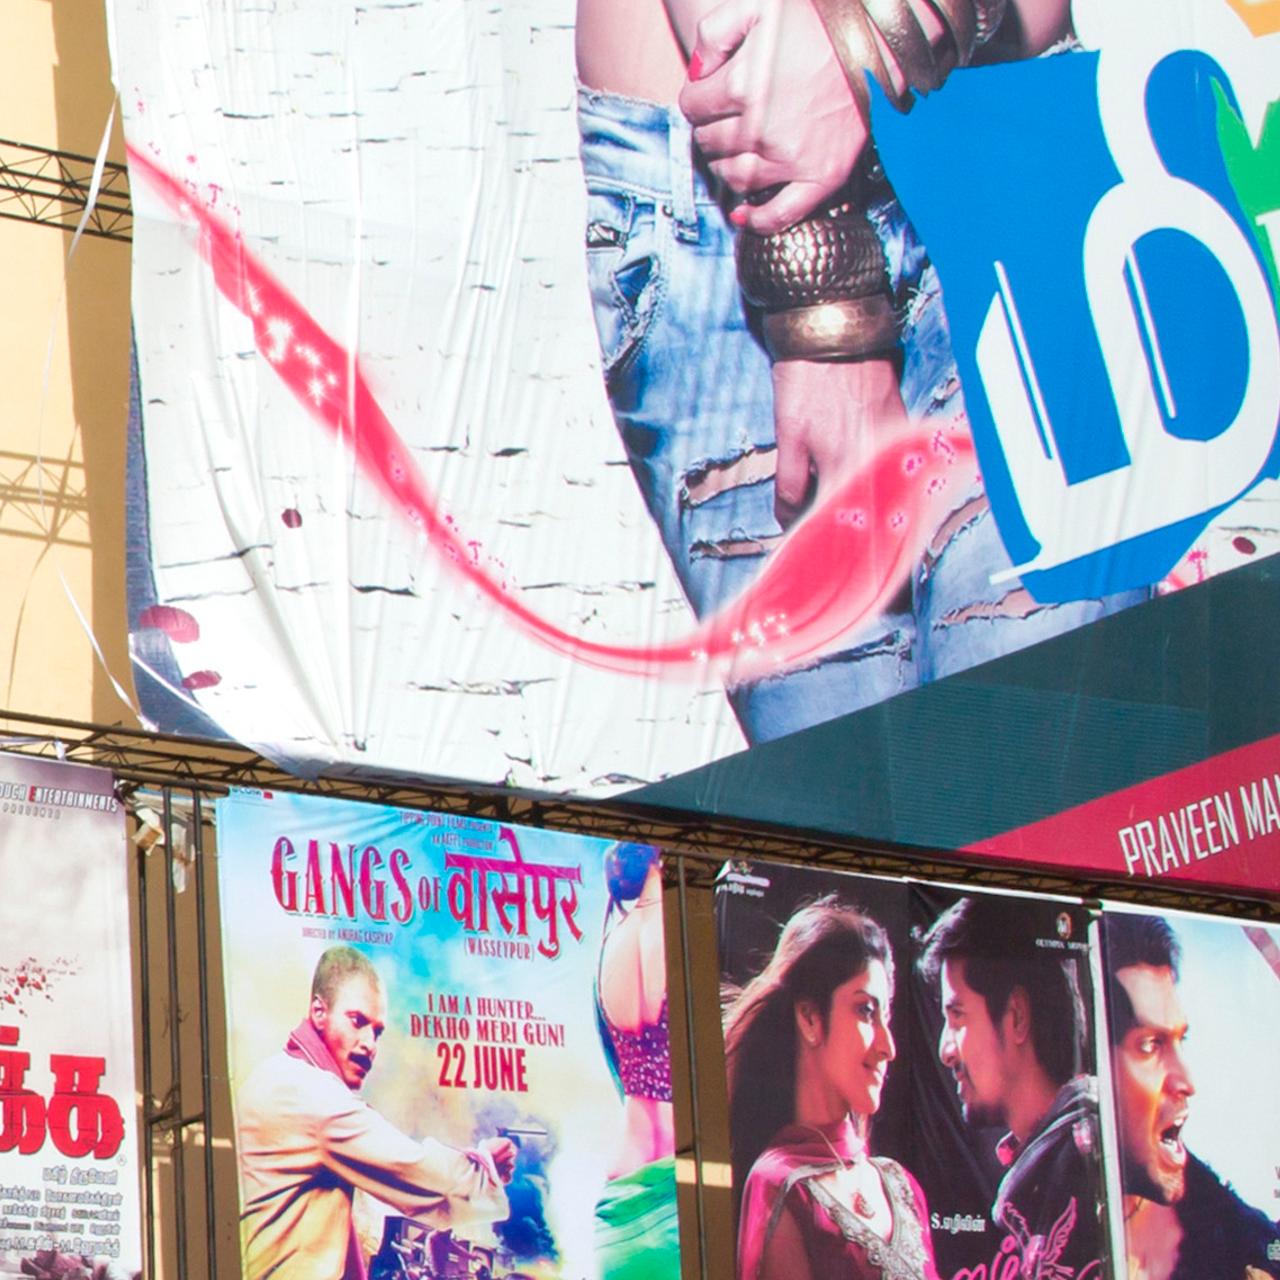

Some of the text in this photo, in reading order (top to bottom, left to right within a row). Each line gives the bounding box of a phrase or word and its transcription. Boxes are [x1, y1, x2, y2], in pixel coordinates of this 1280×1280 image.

[28, 785, 119, 813] ENTERTAINMENTS
[1118, 790, 1240, 877] PRAVEEN
[270, 835, 443, 926] GANGS OF
[444, 824, 585, 959] वासेपुर
[463, 937, 535, 962] (WASSEYPUR)
[438, 993, 472, 1015] AM A
[410, 1014, 566, 1048] DEKHO MERI GUN!
[437, 1041, 529, 1093] 22 JUNE
